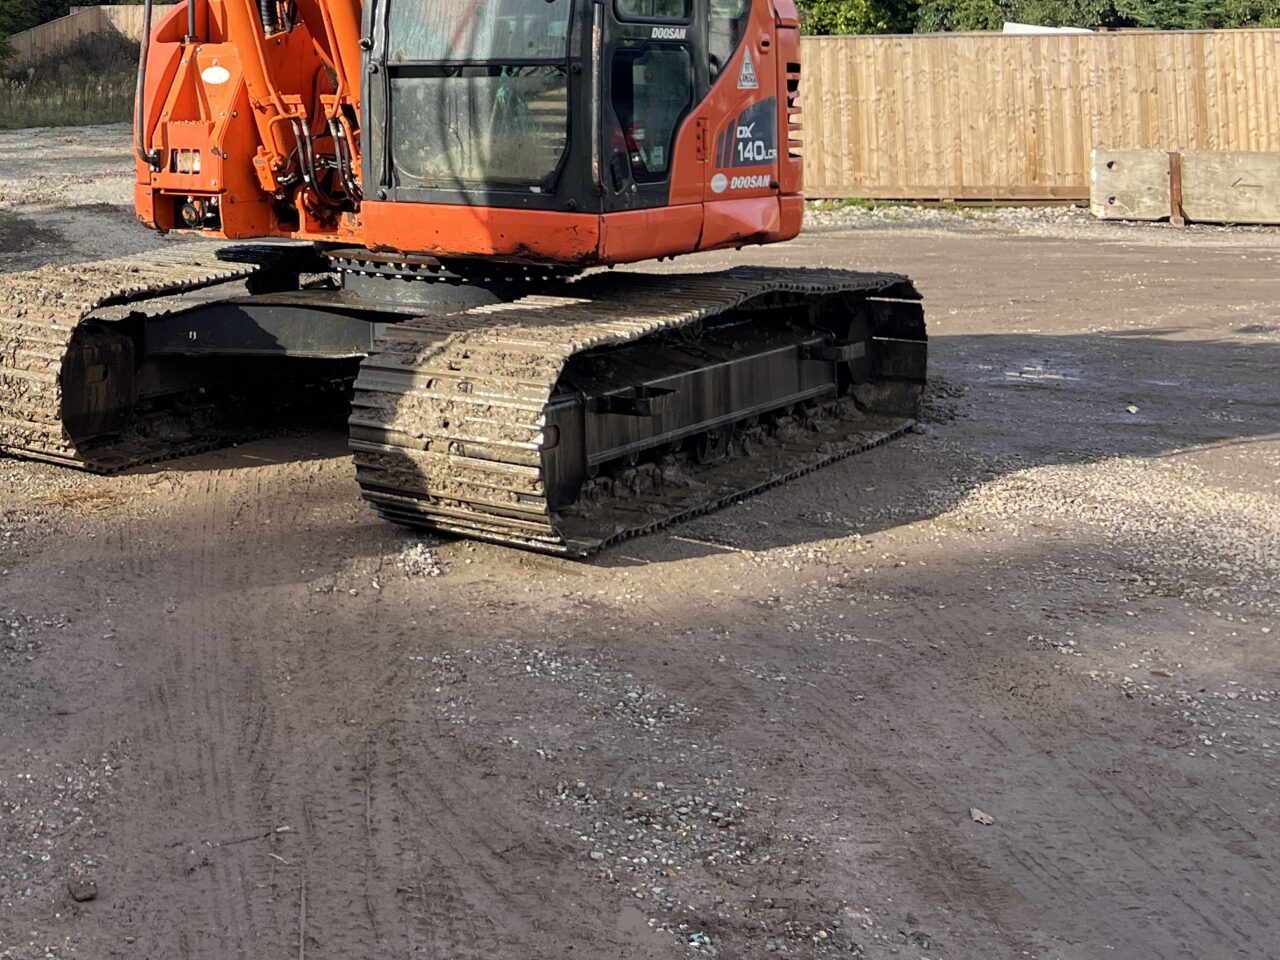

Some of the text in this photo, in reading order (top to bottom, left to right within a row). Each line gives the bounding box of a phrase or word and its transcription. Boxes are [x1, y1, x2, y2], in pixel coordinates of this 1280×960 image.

[651, 27, 687, 39] DOOSAN
[736, 122, 756, 138] DX
[730, 175, 771, 189] DOOSAN
